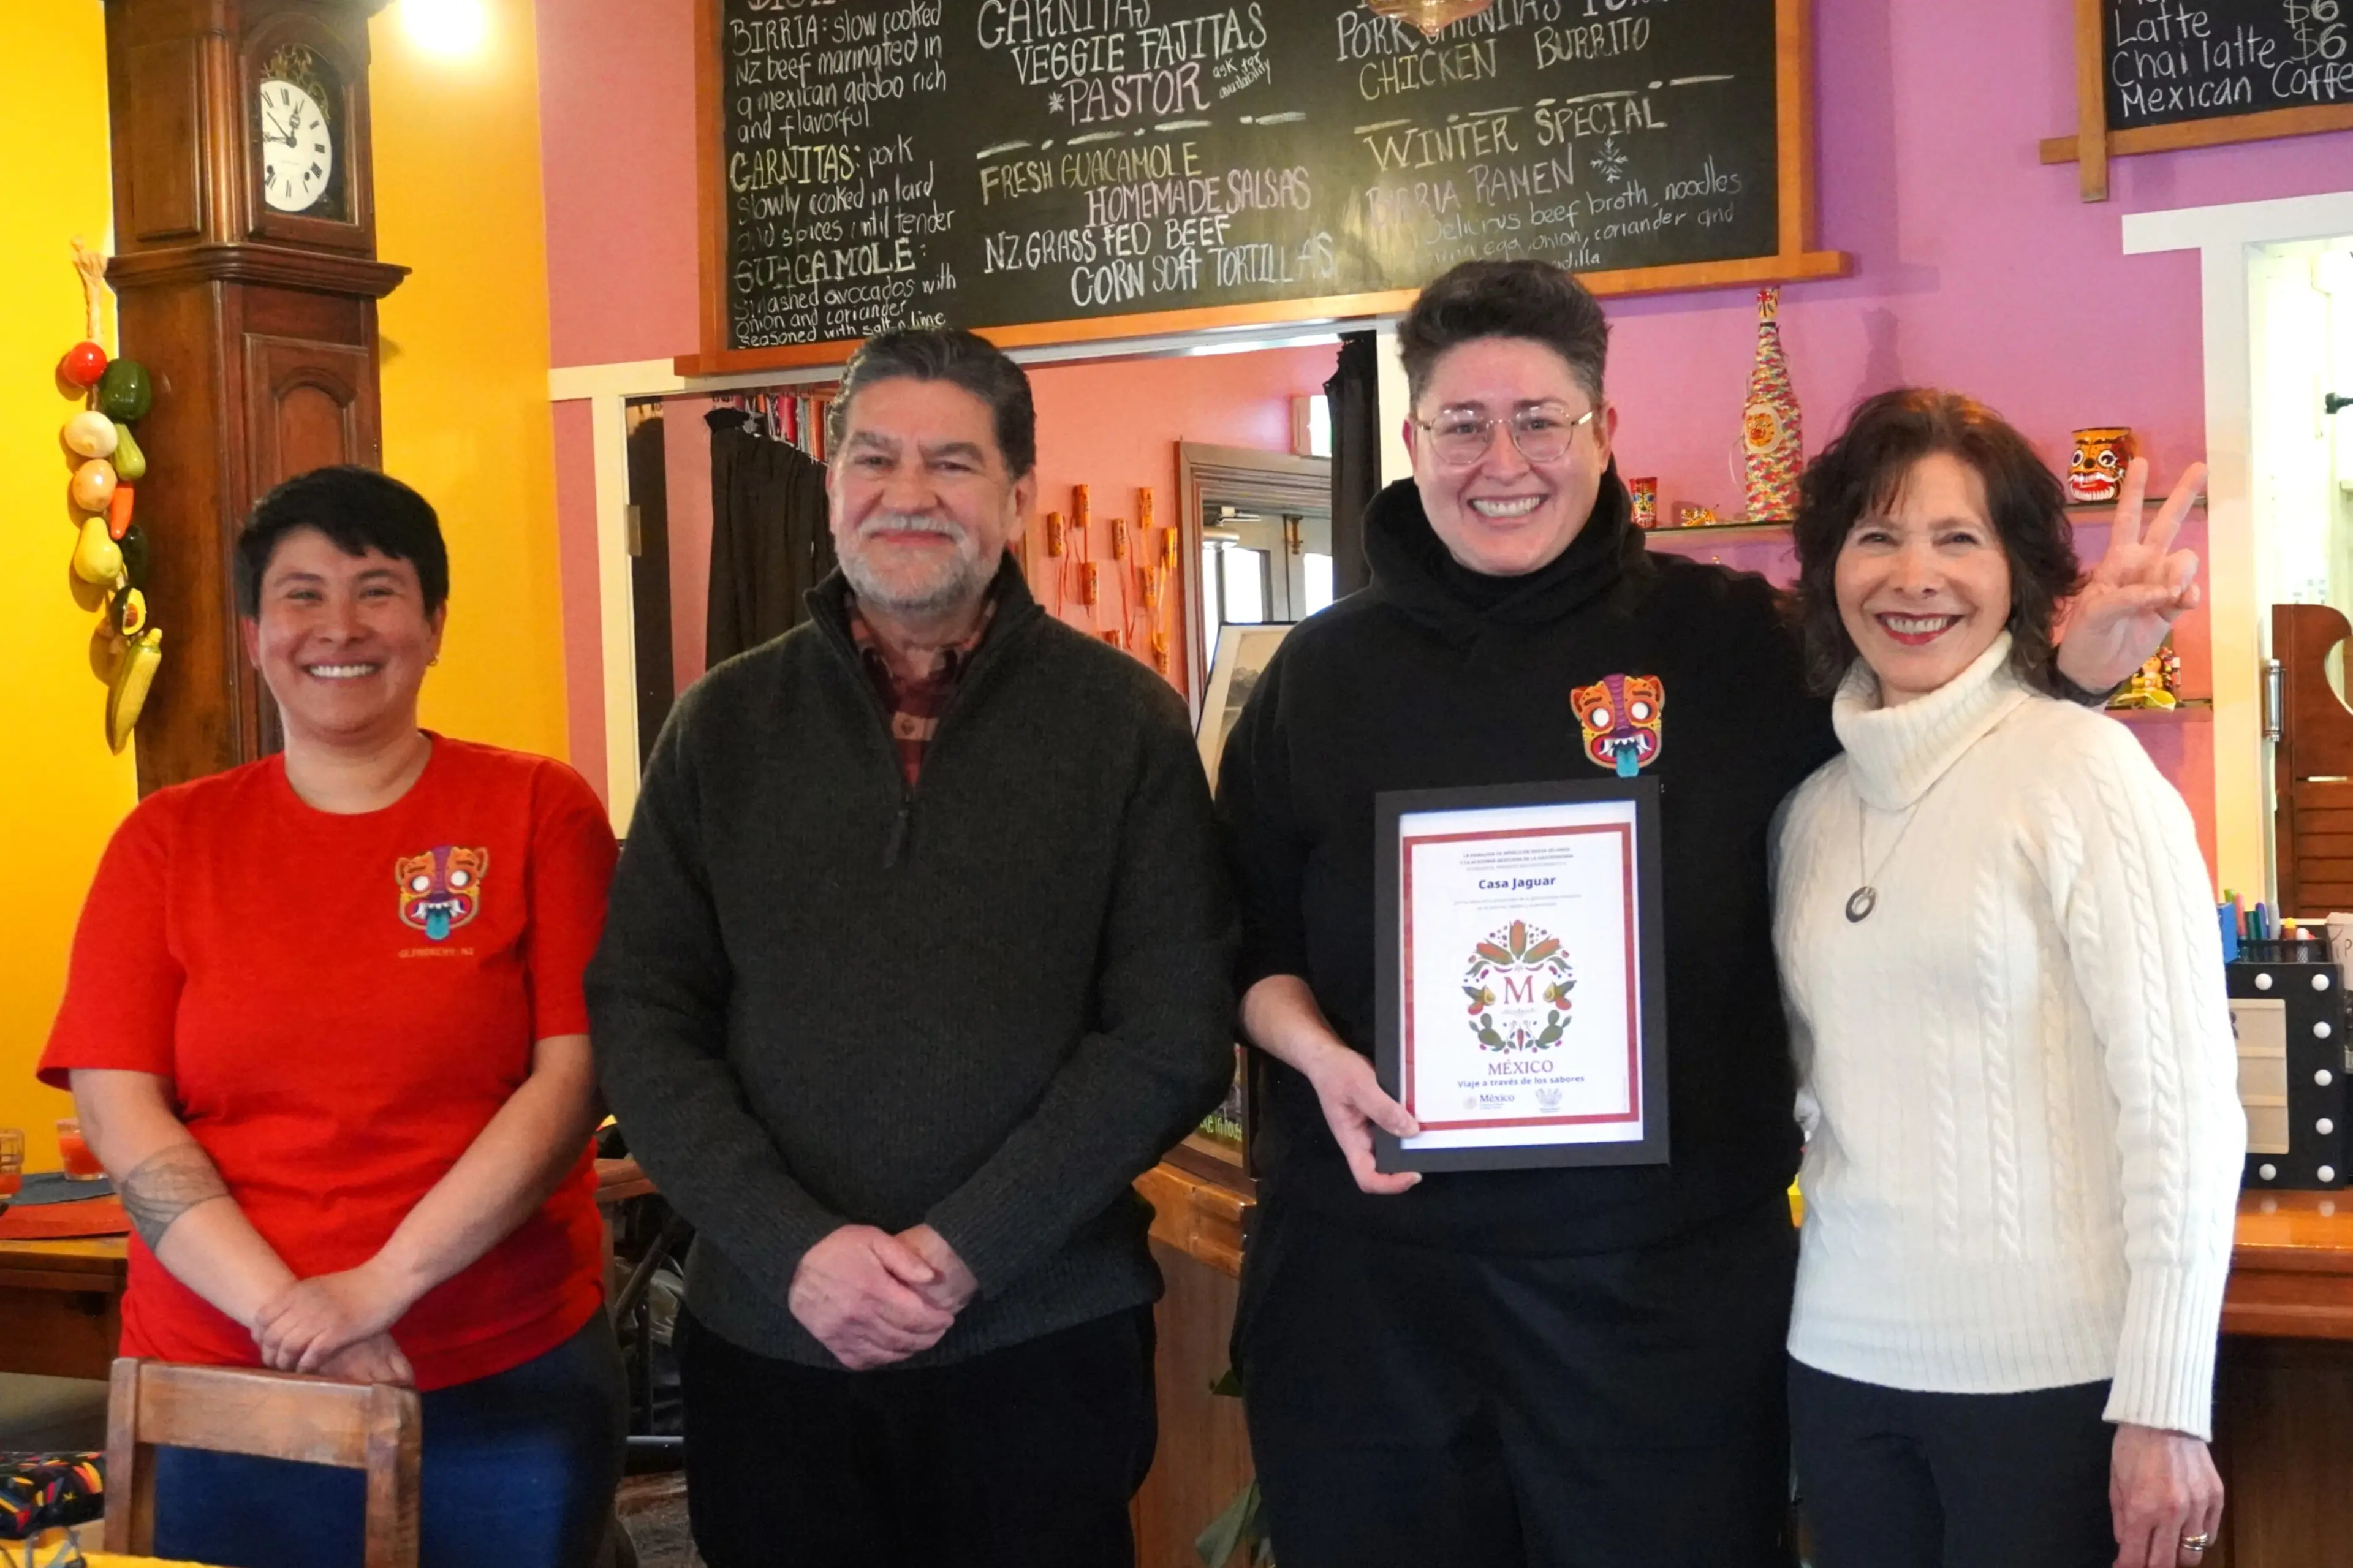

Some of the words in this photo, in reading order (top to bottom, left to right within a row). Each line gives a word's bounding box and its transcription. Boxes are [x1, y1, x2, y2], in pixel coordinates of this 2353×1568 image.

[832, 9, 877, 44] slow
[884, 0, 941, 34] cooked
[1010, 33, 1124, 86] VEGGIE
[1136, 1, 1267, 71] FAJITAS
[1336, 10, 1420, 62] PORK
[1534, 17, 1650, 69] BURRITO
[2115, 2, 2211, 46] Latte
[2283, 0, 2339, 29] $6
[736, 59, 762, 86] NZ
[767, 52, 811, 88] beef
[819, 31, 918, 74] marinated
[925, 35, 942, 59] in
[1213, 56, 1238, 78] ask
[1360, 38, 1497, 100] CHICKEN
[2112, 40, 2188, 88] Chai
[2203, 24, 2276, 72] latte
[2290, 22, 2347, 65] $6
[737, 96, 752, 119] a
[758, 82, 837, 112] mexican
[844, 70, 904, 104] adobo
[913, 61, 946, 92] rich
[2121, 76, 2252, 117] Mexican
[738, 112, 771, 143] and
[779, 103, 870, 146] flavorful
[1363, 115, 1518, 171] WINTER
[1534, 97, 1667, 146] SPECIAL
[868, 134, 913, 178] pork
[980, 159, 1053, 205] FRESH
[1060, 142, 1202, 189] GUACAMOLE
[1468, 142, 1575, 207] RAMEN
[809, 177, 864, 215] cooked
[872, 188, 889, 206] in
[895, 161, 934, 202] lard
[1084, 176, 1224, 229] HOMEMADE
[1226, 165, 1311, 215] SALSAS
[1530, 200, 1580, 228] beef
[1665, 154, 1742, 201] noodles
[782, 219, 843, 250] spices
[895, 200, 956, 233] tender
[1594, 208, 1687, 240] coriander
[1698, 201, 1734, 228] and
[983, 230, 1022, 275] NZ
[1026, 228, 1096, 268] GRASS
[1165, 214, 1232, 249] BEEF
[824, 275, 915, 305] avocados
[922, 262, 956, 294] with
[1071, 259, 1145, 306] CORN
[738, 326, 816, 349] seasoned
[824, 322, 857, 339] with
[862, 317, 890, 335] salt
[911, 311, 946, 328] lime
[790, 308, 819, 328] and
[827, 299, 907, 326] coriander
[1479, 879, 1509, 889] Casa
[1512, 877, 1556, 890] Jaguar
[1504, 975, 1534, 1004] M
[1458, 1080, 1480, 1089] Viaje
[1490, 1077, 1518, 1087] través
[1550, 1075, 1585, 1085] sabores
[1488, 1059, 1554, 1075] MÉXICO
[1480, 1093, 1515, 1102] México
